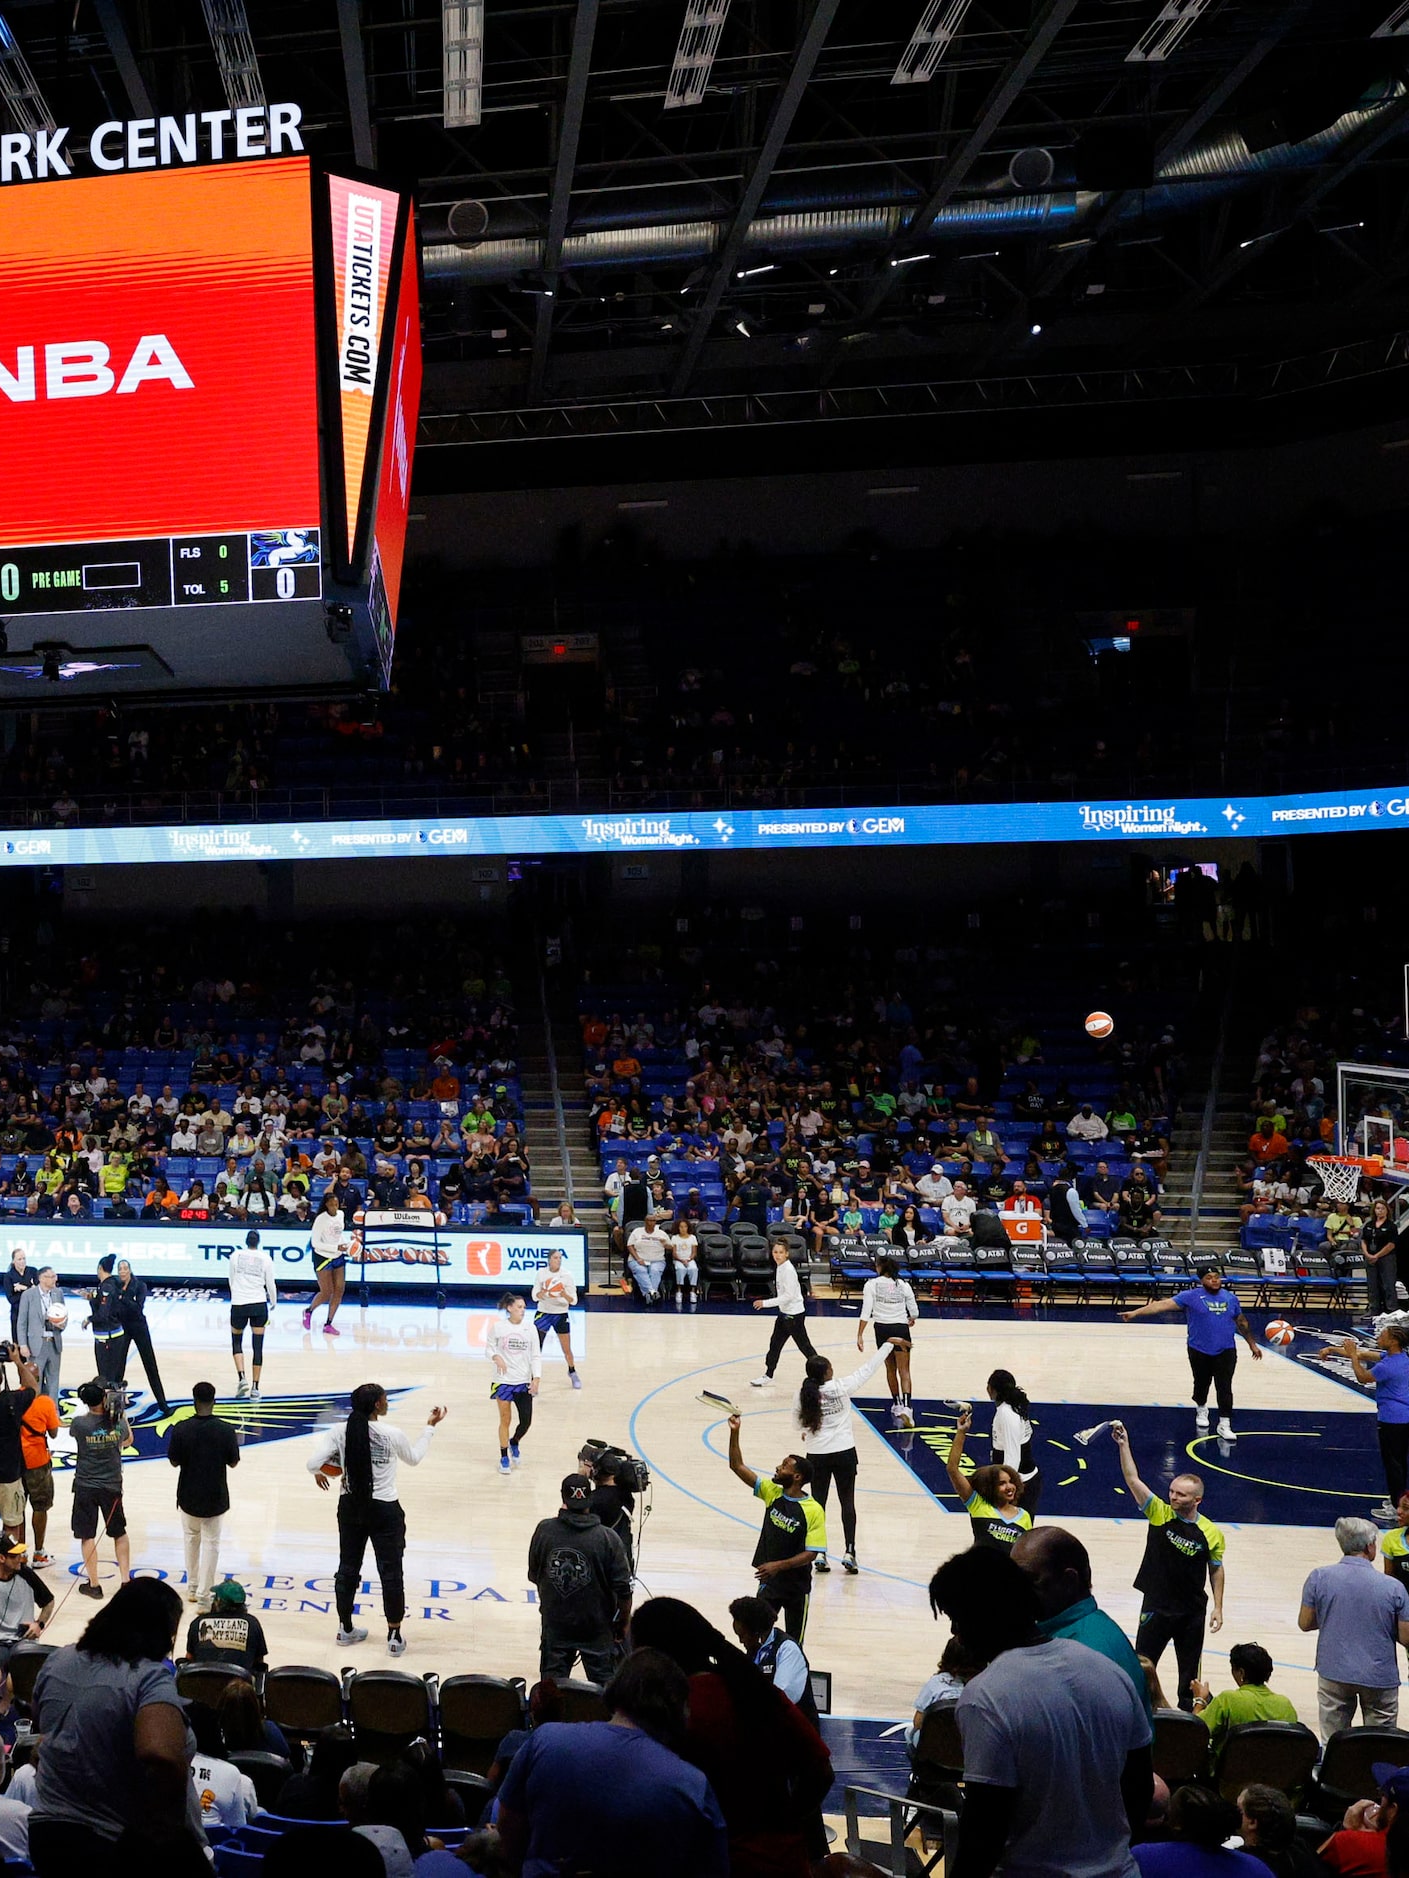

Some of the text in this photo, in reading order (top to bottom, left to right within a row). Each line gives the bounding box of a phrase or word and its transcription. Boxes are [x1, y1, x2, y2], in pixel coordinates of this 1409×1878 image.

[91, 102, 305, 170] CENTER
[344, 204, 375, 384] UTATICKETS.COM
[180, 545, 228, 559] FLS 0
[32, 572, 51, 589] PRE
[53, 569, 81, 587] GAME
[276, 567, 296, 599] 0
[183, 580, 229, 595] TOL 5
[1078, 805, 1175, 831] Inspiring
[1272, 806, 1348, 822] PRESENTED
[1349, 804, 1368, 816] BY
[581, 818, 670, 843] Inspiring
[758, 817, 905, 835] PRESENTED BY GEM
[1121, 823, 1167, 834] Women
[168, 830, 251, 854] Inspiring
[332, 829, 468, 845] PRESENTED BY GEM
[620, 834, 663, 846] Women
[15, 840, 51, 855] GEM
[393, 1212, 420, 1220] Wilson
[1015, 1222, 1028, 1234] G
[867, 1238, 889, 1246] WNBA
[1151, 1241, 1169, 1249] AT&T
[45, 1241, 102, 1257] ALL
[107, 1243, 192, 1260] HERE.
[198, 1244, 242, 1260] TR
[263, 1246, 305, 1262] TO
[887, 1249, 905, 1257] AT&T
[919, 1249, 936, 1257] AT&T
[987, 1250, 1005, 1258] AT&T
[1056, 1251, 1074, 1259] AT&T
[507, 1260, 548, 1271] APP
[1301, 1256, 1327, 1264] WNBA
[770, 1507, 796, 1526] FLIGHT
[773, 1517, 797, 1534] CREW
[988, 1522, 1017, 1536] FLIGHT
[423, 1579, 540, 1603] PA
[213, 1620, 248, 1631] MY LAND
[213, 1630, 247, 1643] MY RULES
